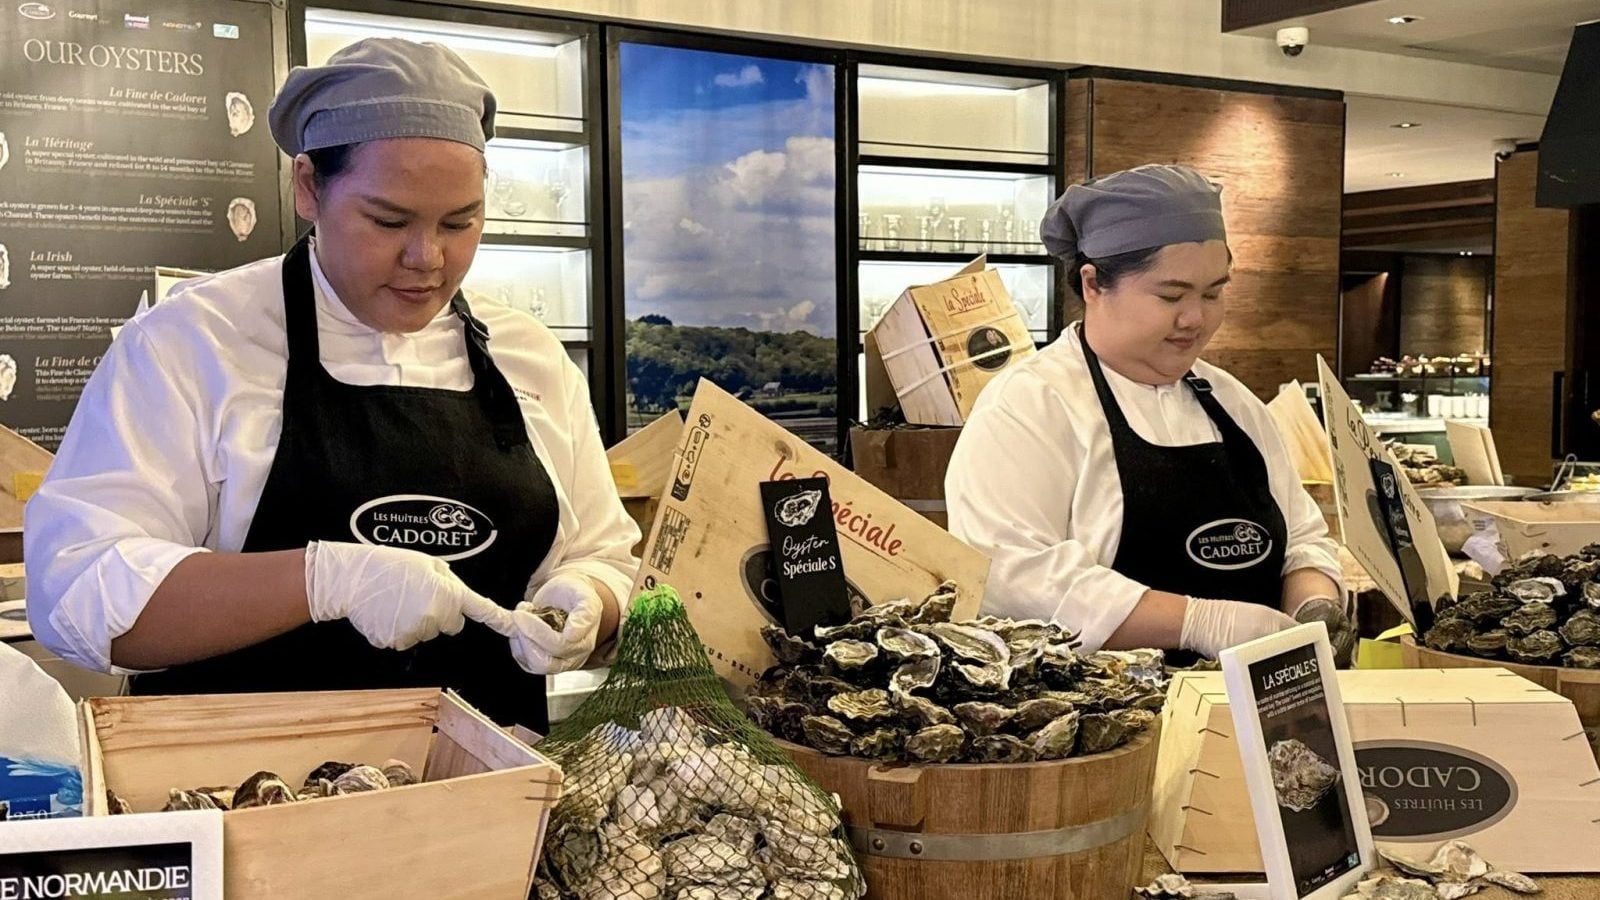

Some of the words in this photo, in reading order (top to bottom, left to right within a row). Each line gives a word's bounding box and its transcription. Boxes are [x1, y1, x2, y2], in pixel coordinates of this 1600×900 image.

[23, 38, 85, 66] OUR
[90, 44, 204, 76] OYSTERS
[109, 86, 123, 98] La
[125, 88, 148, 100] Fine
[150, 91, 163, 101] de
[165, 92, 207, 104] Cadoret
[25, 136, 39, 146] La
[52, 151, 74, 159] special
[108, 162, 133, 170] refined
[10, 202, 30, 210] oyster
[139, 194, 152, 205] La
[154, 194, 198, 208] Spéciale
[30, 251, 44, 262] La
[46, 251, 72, 262] Irish
[57, 264, 80, 273] special
[942, 295, 956, 312] La
[952, 288, 986, 312] Spéciale
[14, 318, 36, 326] oyster,
[36, 356, 48, 367] La
[51, 356, 75, 367] Fine
[78, 356, 90, 367] de
[1346, 406, 1356, 434] La
[373, 512, 388, 522] LES
[390, 512, 428, 524] HUÎTRES
[372, 525, 474, 546] CADORET
[782, 534, 830, 560] Oyster
[1200, 542, 1262, 560] CADORET
[783, 557, 828, 580] Spéciale
[829, 556, 836, 570] S
[706, 645, 761, 680] UR-BELO
[1262, 674, 1276, 690] LA
[1275, 663, 1312, 686] SPÉCIALE
[1358, 766, 1481, 792] CADOR
[1394, 798, 1456, 812] HUÎTRES
[1460, 798, 1483, 811] LES
[24, 866, 190, 899] NORMANDIE
